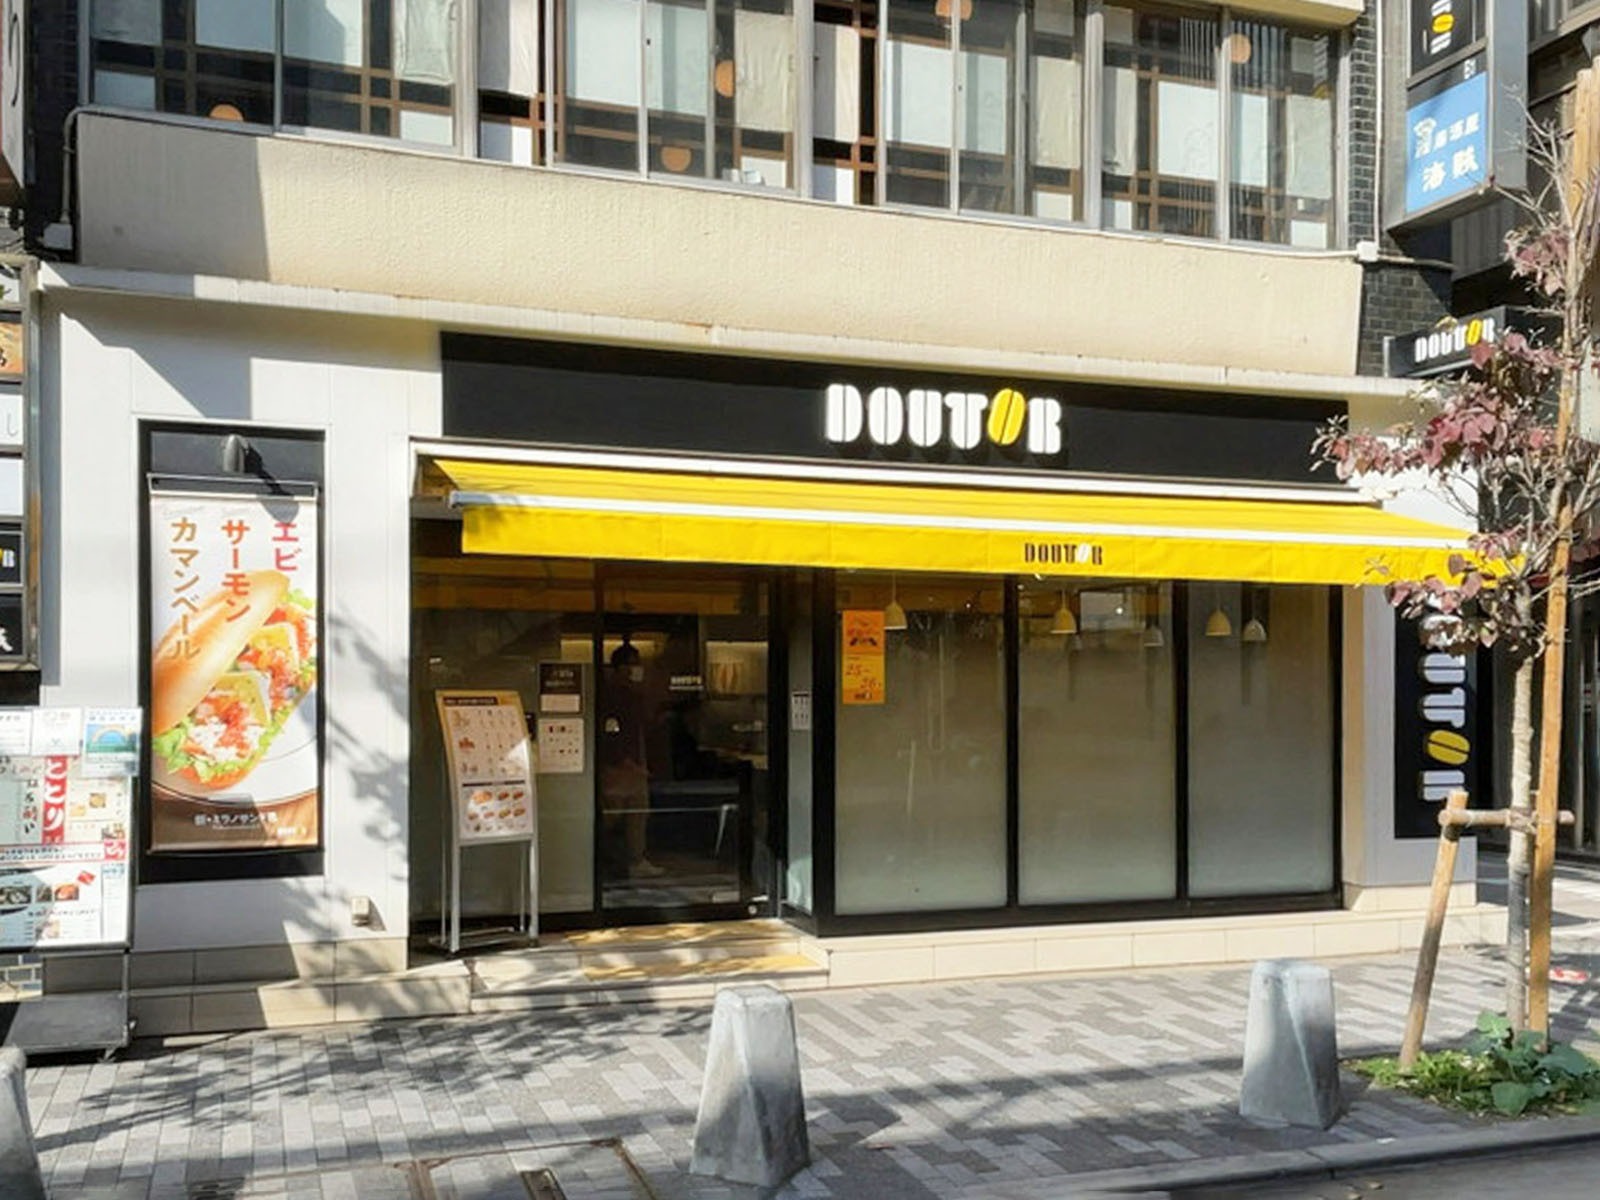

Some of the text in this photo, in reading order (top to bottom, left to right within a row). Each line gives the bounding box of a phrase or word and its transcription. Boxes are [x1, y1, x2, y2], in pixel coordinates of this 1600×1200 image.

[826, 383, 1062, 455] DOUTOR
[221, 519, 251, 623] サーモン
[272, 521, 302, 572] エビ
[1024, 542, 1103, 566] DOUTOR
[170, 517, 201, 660] カマンベール
